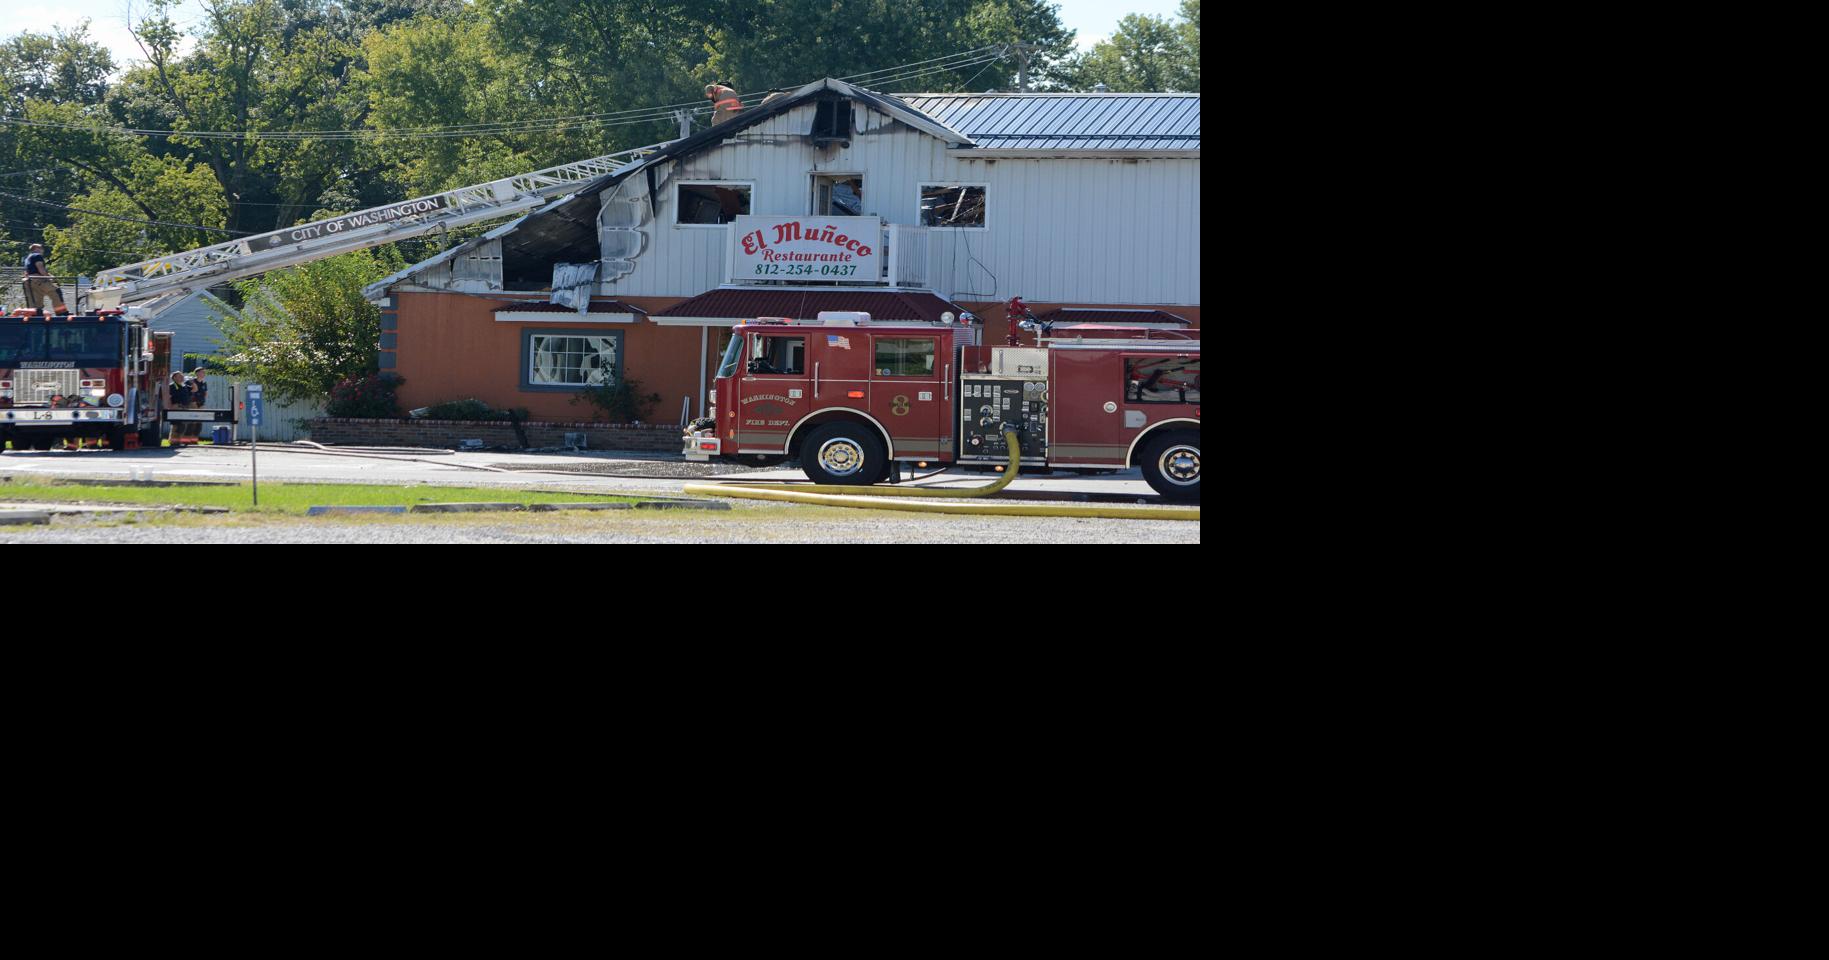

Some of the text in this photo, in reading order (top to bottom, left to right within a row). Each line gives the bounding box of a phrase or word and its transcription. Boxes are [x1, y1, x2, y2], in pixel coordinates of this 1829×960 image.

[291, 199, 439, 242] CITY OF WASHINGTON
[741, 221, 872, 257] El Muñeco
[761, 248, 852, 262] Restaurante
[755, 263, 857, 276] 812-254-0437
